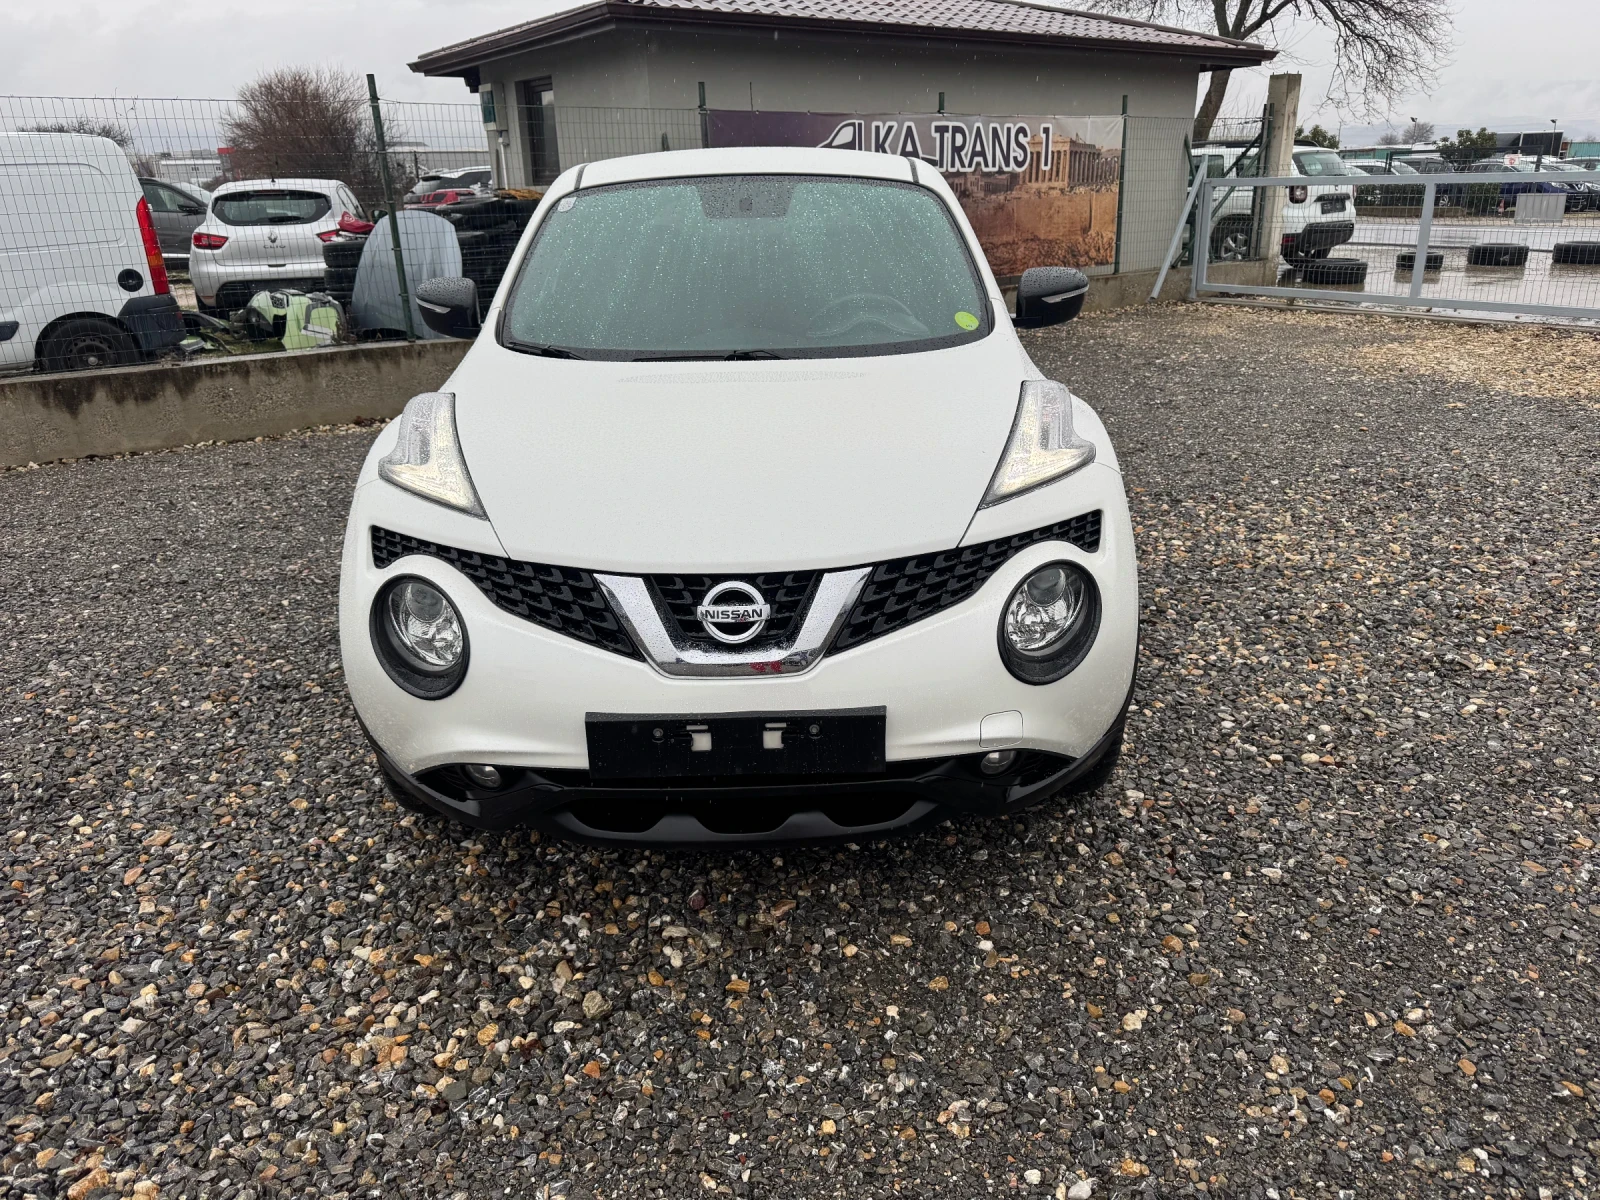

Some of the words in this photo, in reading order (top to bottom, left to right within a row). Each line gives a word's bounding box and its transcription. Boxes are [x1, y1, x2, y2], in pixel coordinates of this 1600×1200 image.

[933, 122, 1029, 171] TRANS
[1041, 123, 1052, 170] 1
[705, 608, 763, 619] NISSAN
